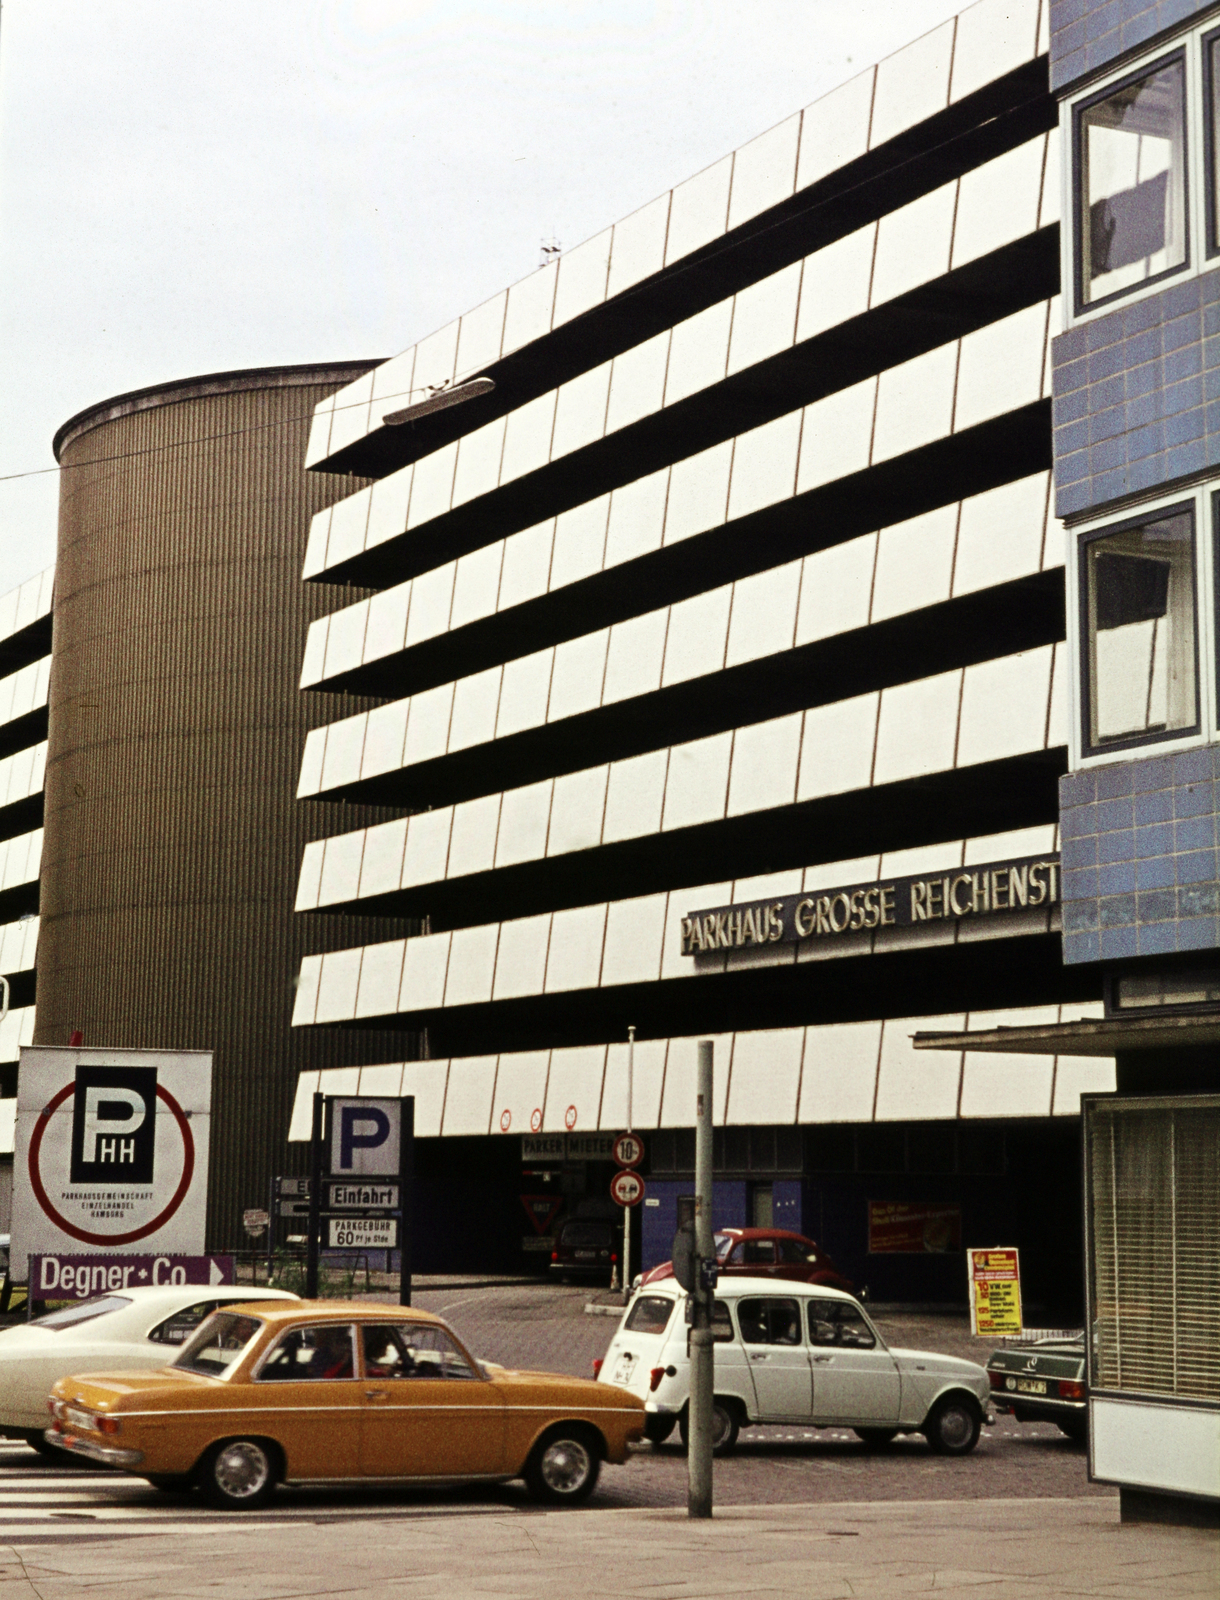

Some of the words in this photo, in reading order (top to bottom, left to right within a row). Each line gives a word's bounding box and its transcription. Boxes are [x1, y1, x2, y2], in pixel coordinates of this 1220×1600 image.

[680, 903, 783, 952] PARKHAUS
[794, 886, 896, 938] GROSSE
[82, 1086, 146, 1163] P
[340, 1107, 390, 1169] P
[524, 1139, 562, 1153] PARKER
[100, 1138, 136, 1164] HH
[620, 1140, 633, 1161] 10
[335, 1187, 392, 1204] Einfahrt
[90, 1210, 124, 1218] HAMBURG
[337, 1231, 354, 1245] 60
[40, 1257, 135, 1297] Degner
[152, 1257, 187, 1286] Co
[978, 1281, 989, 1291] 10
